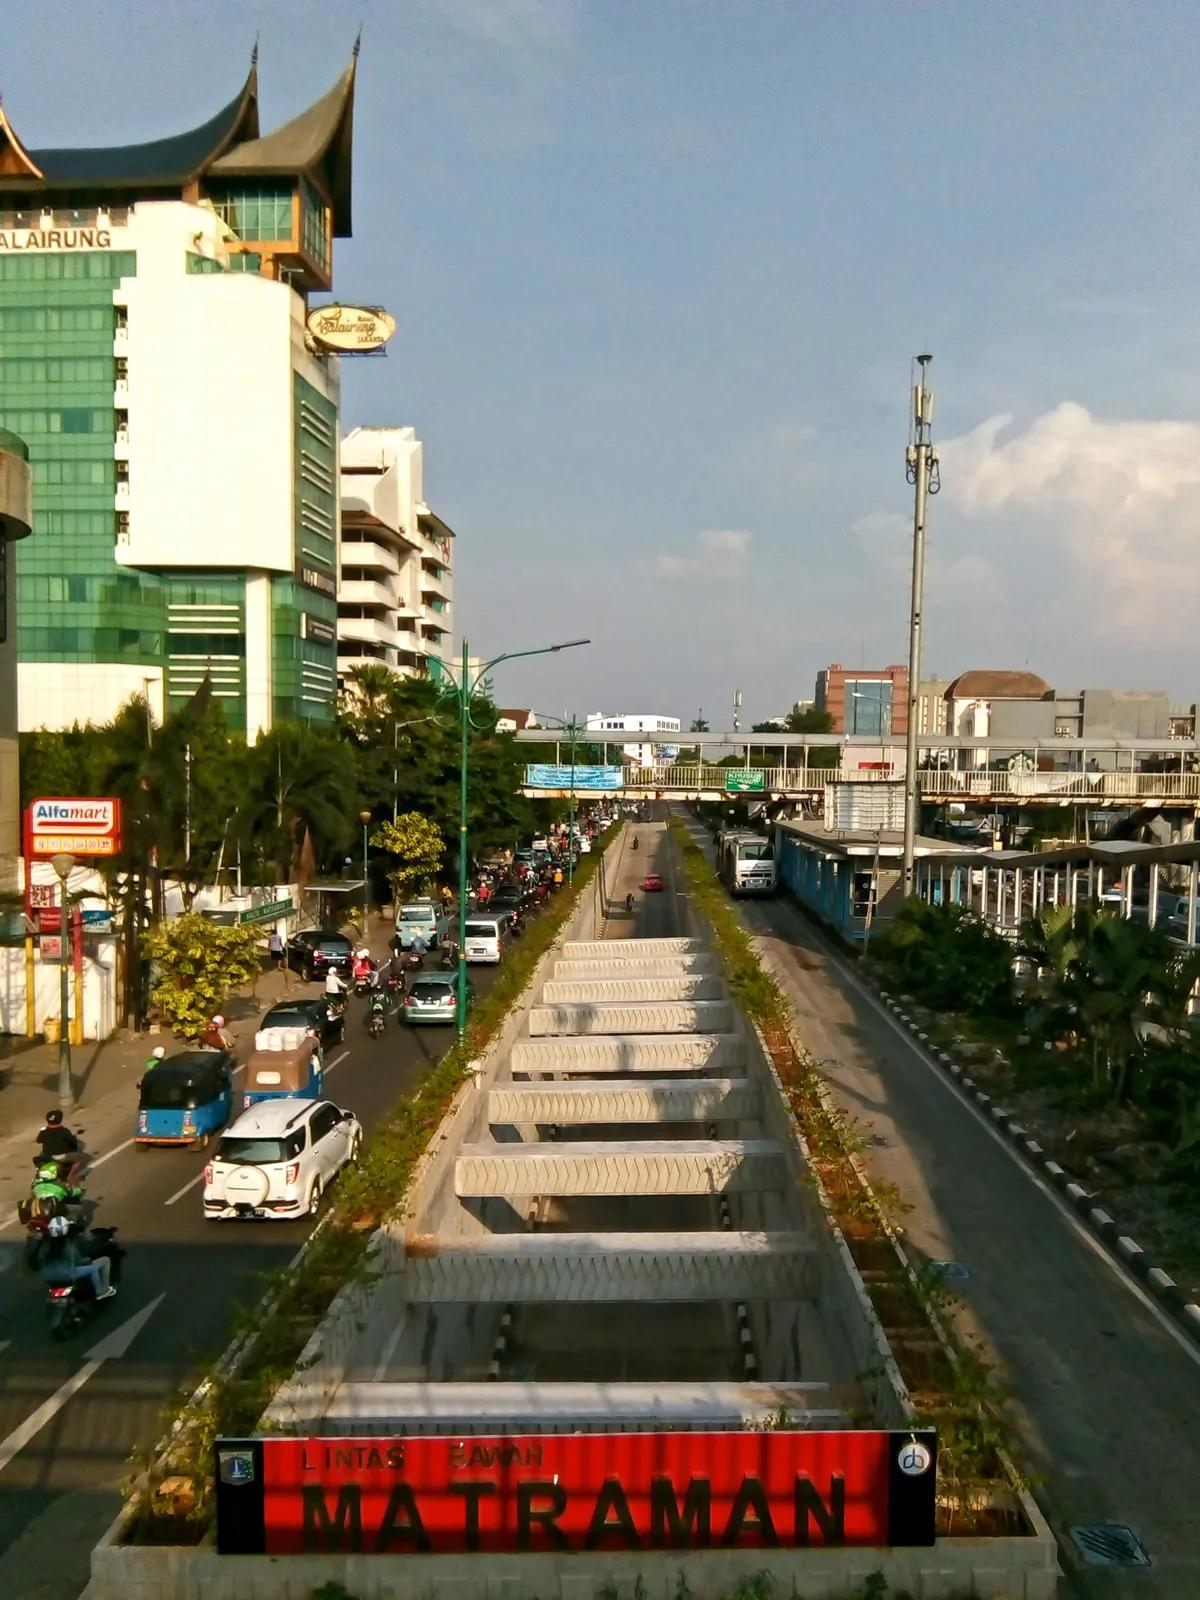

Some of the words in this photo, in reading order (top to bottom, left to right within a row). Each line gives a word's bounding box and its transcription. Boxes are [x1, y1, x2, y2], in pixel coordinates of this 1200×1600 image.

[37, 804, 109, 819] Alfamart
[302, 1445, 406, 1471] LINTAS
[448, 1442, 543, 1468] BAWAH
[301, 1472, 847, 1551] MATRAMAN
